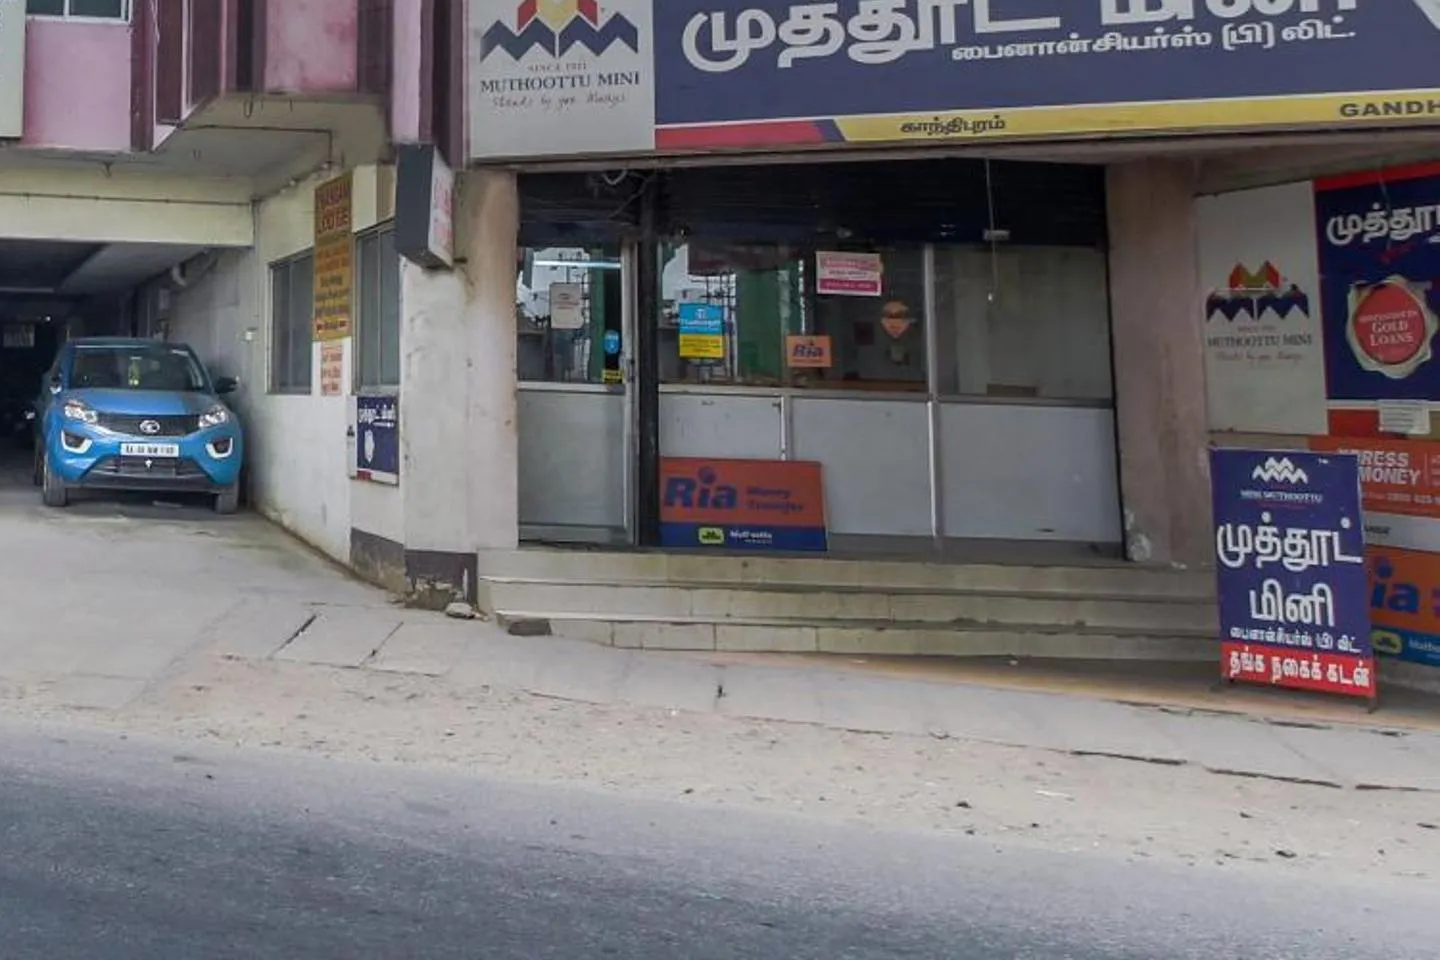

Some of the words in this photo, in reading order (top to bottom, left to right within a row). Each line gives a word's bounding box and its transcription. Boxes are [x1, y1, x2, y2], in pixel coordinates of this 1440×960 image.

[480, 75, 591, 93] MUTHOOTTU
[597, 71, 640, 86] MINI
[663, 465, 738, 510] Ria
[1217, 512, 1363, 572] முத்தூட்
[1250, 579, 1335, 627] மினி
